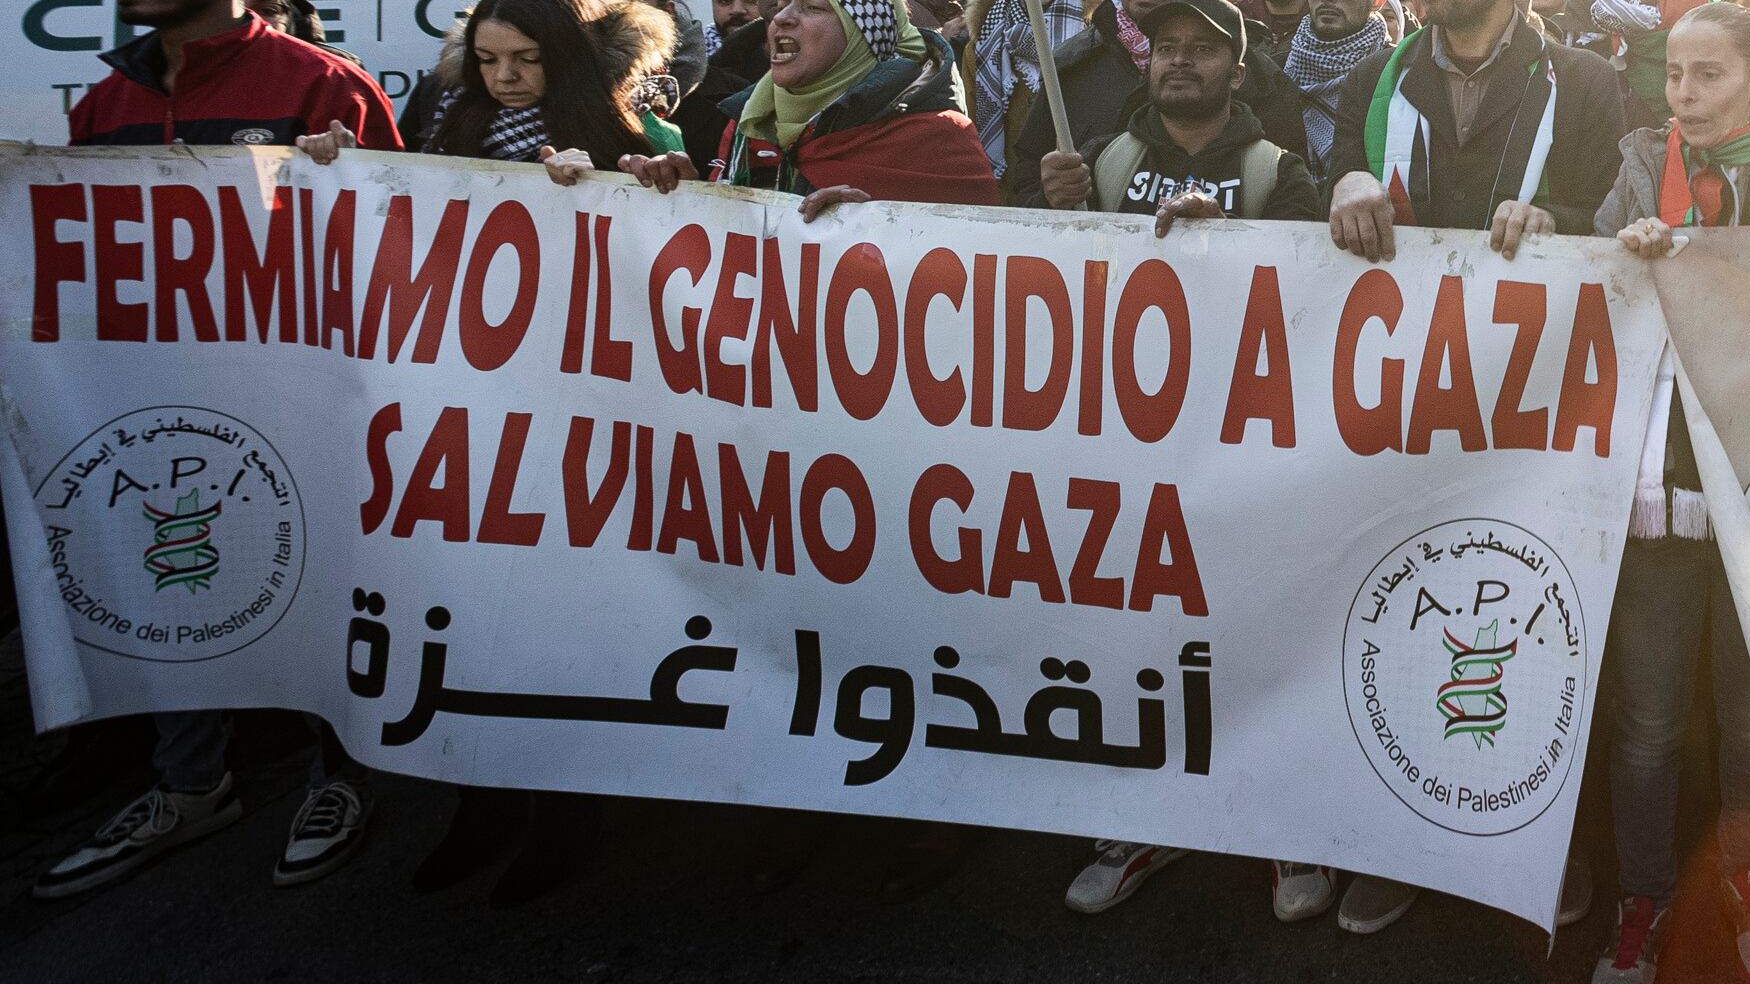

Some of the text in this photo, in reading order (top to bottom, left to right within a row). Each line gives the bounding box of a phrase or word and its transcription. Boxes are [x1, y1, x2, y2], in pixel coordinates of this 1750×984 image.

[30, 183, 1617, 459] FERMIAMO IL GENOCIDIO A GAZA
[108, 456, 250, 508] A.P.I.
[360, 402, 1210, 617] SALVIAMO GAZA
[47, 519, 292, 644] Associazione dei Palestinesi in Italia
[1409, 579, 1546, 646] A.P.I.
[347, 587, 1213, 787] أنقذوا غزة
[1360, 638, 1576, 813] Associazione dei Palestinesi in Italia
